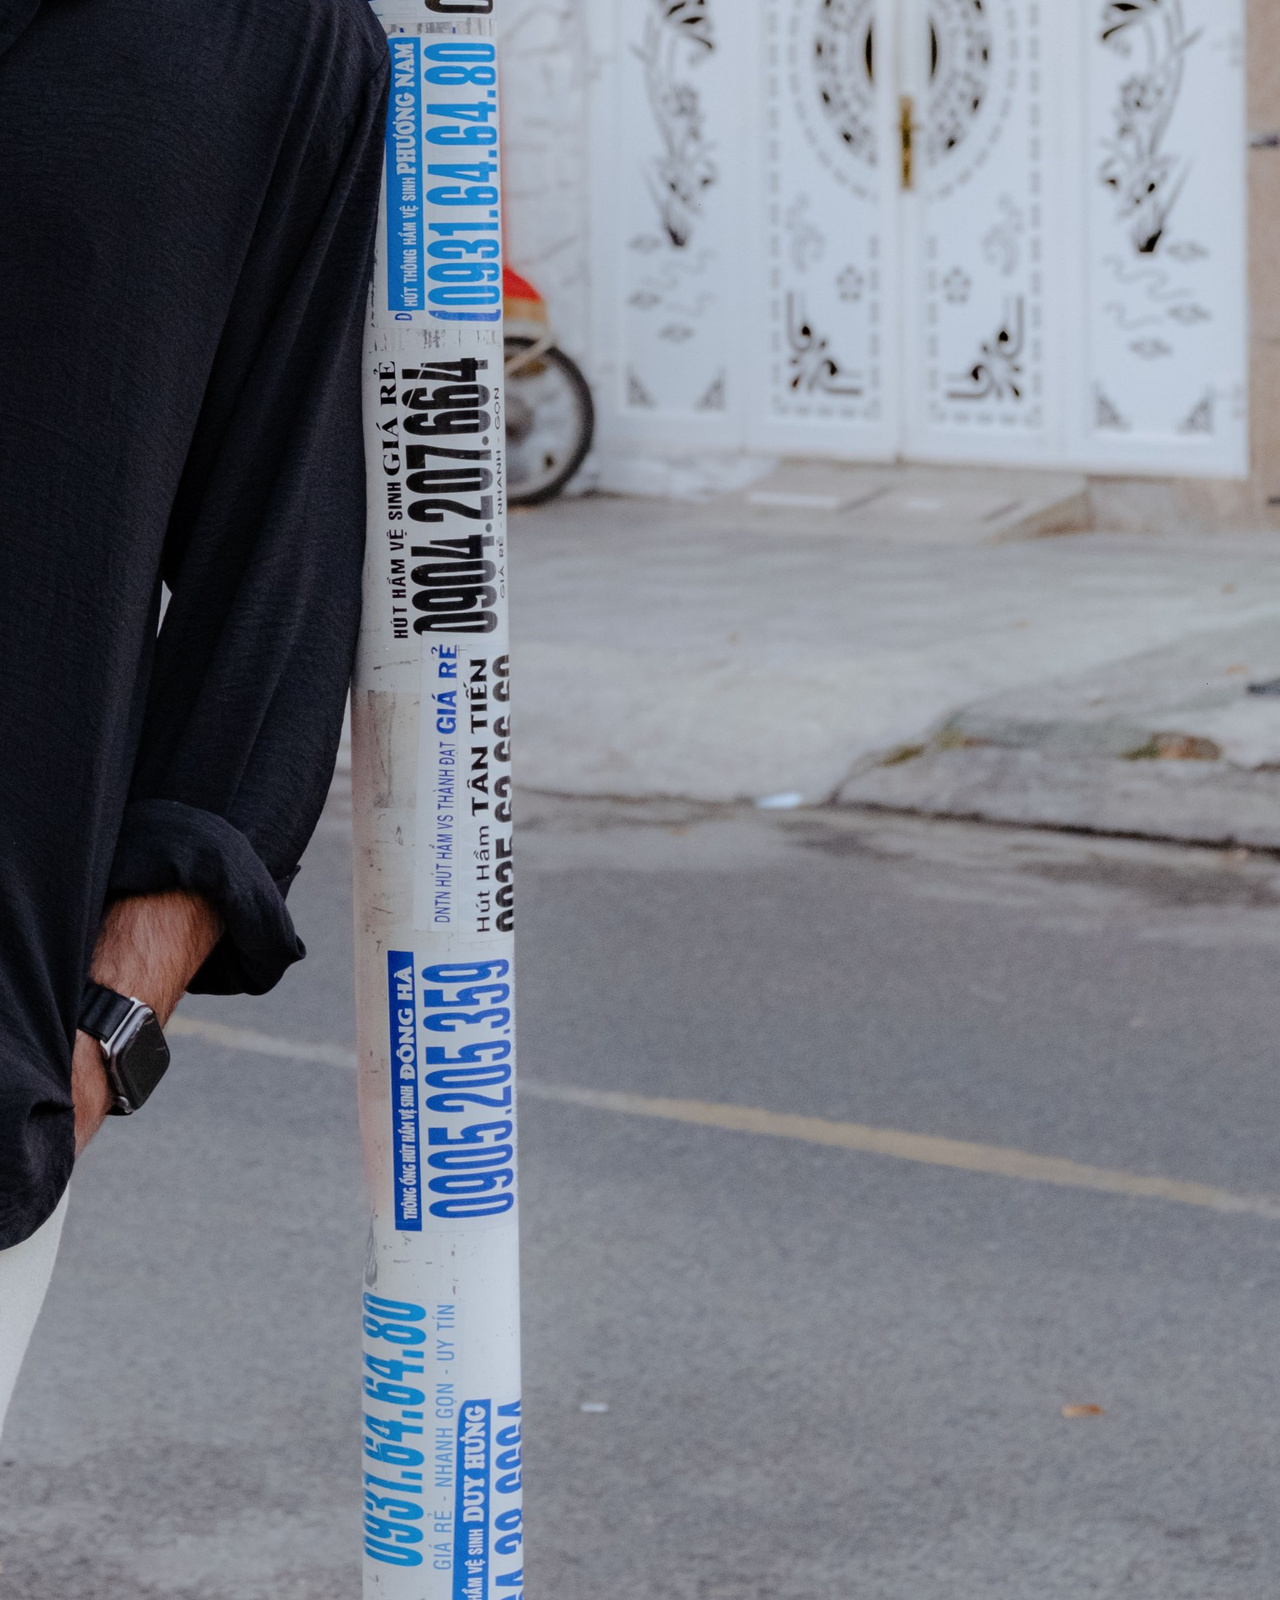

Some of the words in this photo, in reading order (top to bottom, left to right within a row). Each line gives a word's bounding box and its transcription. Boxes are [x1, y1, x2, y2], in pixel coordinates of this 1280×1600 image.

[394, 42, 415, 87] NAM
[391, 93, 417, 175] PHƯƠNG
[401, 177, 416, 202] SINH
[423, 42, 500, 306] 0931.64.64.80
[399, 205, 419, 219] VỆ
[399, 249, 418, 284] THÔNG
[400, 286, 418, 307] HÚT
[373, 360, 398, 407] RẺ
[376, 416, 401, 476] GIÁ
[401, 357, 498, 636] 0904.207.664
[495, 449, 504, 516] NHANH
[387, 482, 403, 520] SINH
[386, 529, 407, 551] VỆ
[389, 606, 408, 639] HÚT
[430, 644, 457, 679] RẺ
[431, 690, 457, 735] GIÁ
[463, 658, 488, 734] TIẾN
[439, 741, 458, 766] ĐẠT
[432, 769, 455, 810] THÀNH
[467, 746, 489, 817] TÂN
[436, 814, 453, 830] VS
[473, 825, 490, 881] Hầm
[430, 863, 452, 887] HÚT
[434, 890, 451, 923] DNTN
[476, 890, 490, 933] Hút
[393, 966, 413, 1001] HÀ
[396, 1008, 416, 1080] ĐÔNG
[400, 1085, 415, 1108] SINH
[421, 958, 514, 1219] 0905.205.359
[399, 1108, 418, 1120] VỆ
[398, 1144, 416, 1163] HÚT
[400, 1187, 417, 1220] THÔNG
[431, 1304, 454, 1332] TÍN
[436, 1339, 454, 1361] UY
[436, 1383, 457, 1419] GỌN
[361, 1292, 427, 1567] 0931.64.64.80
[459, 1405, 486, 1470] HƯNG
[434, 1427, 453, 1488] NHANH
[462, 1475, 486, 1523] DUY
[427, 1510, 452, 1533] RẺ
[429, 1542, 451, 1570] GIÁ
[468, 1529, 483, 1555] SINH
[464, 1558, 486, 1574] VỆ
